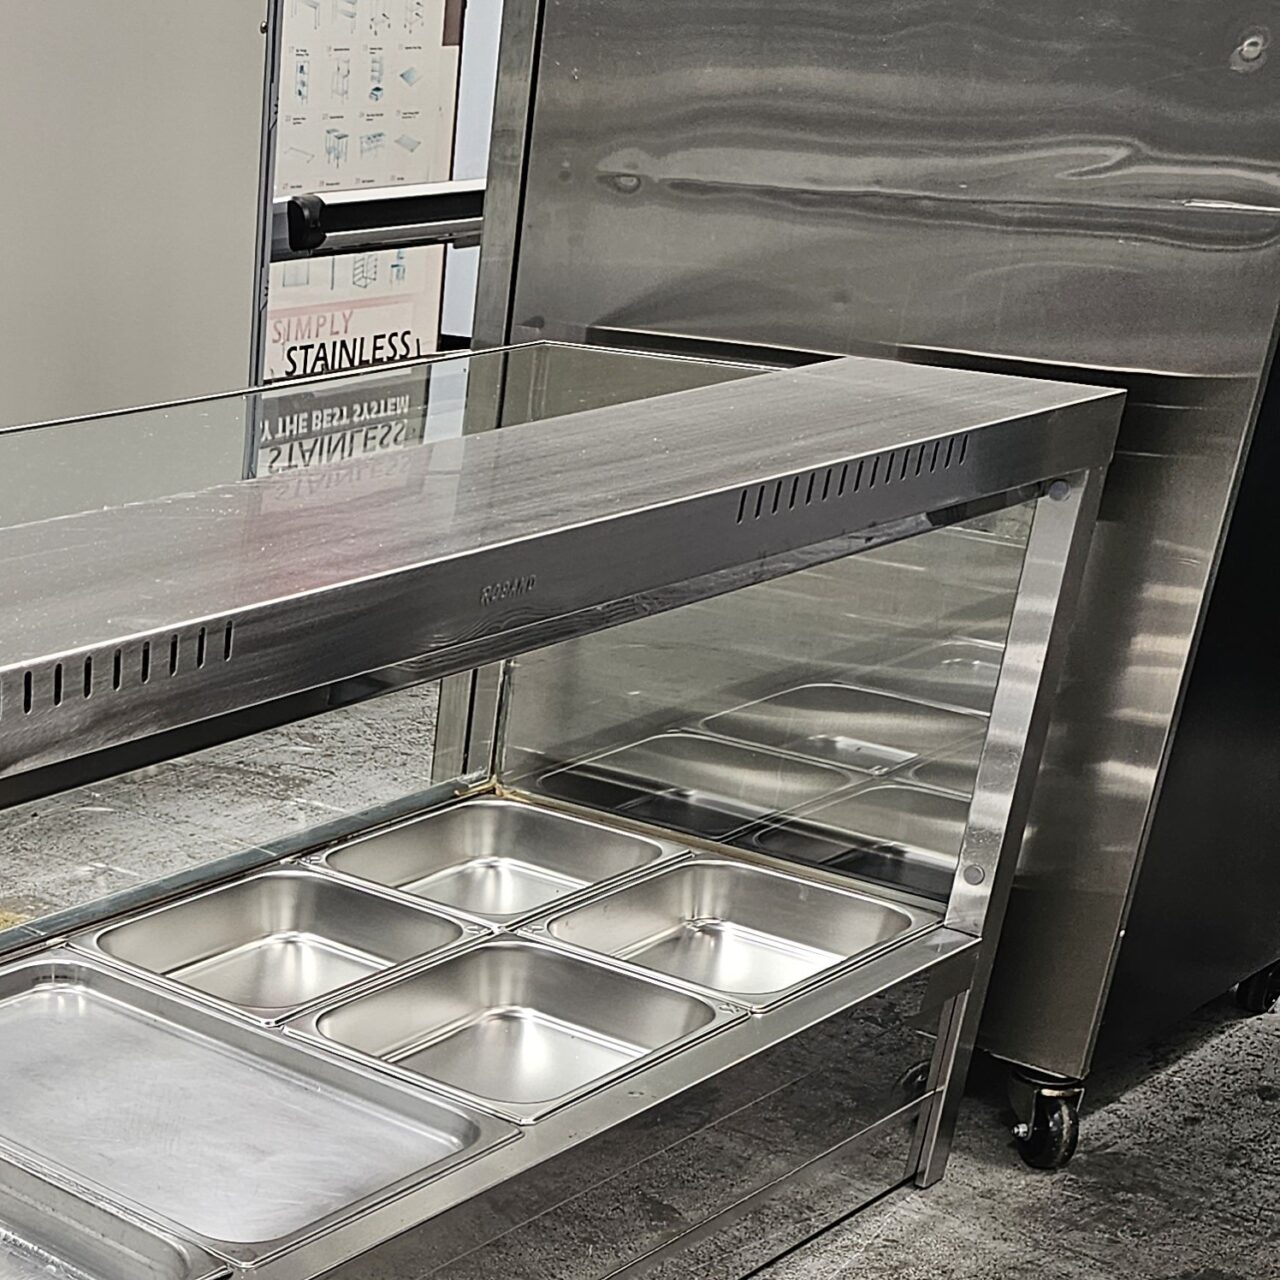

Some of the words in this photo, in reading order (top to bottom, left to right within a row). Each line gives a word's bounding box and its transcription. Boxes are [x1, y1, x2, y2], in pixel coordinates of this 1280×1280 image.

[271, 310, 354, 344] SIMPLY
[285, 330, 411, 377] STAINLESS
[480, 574, 537, 607] ROBAND
